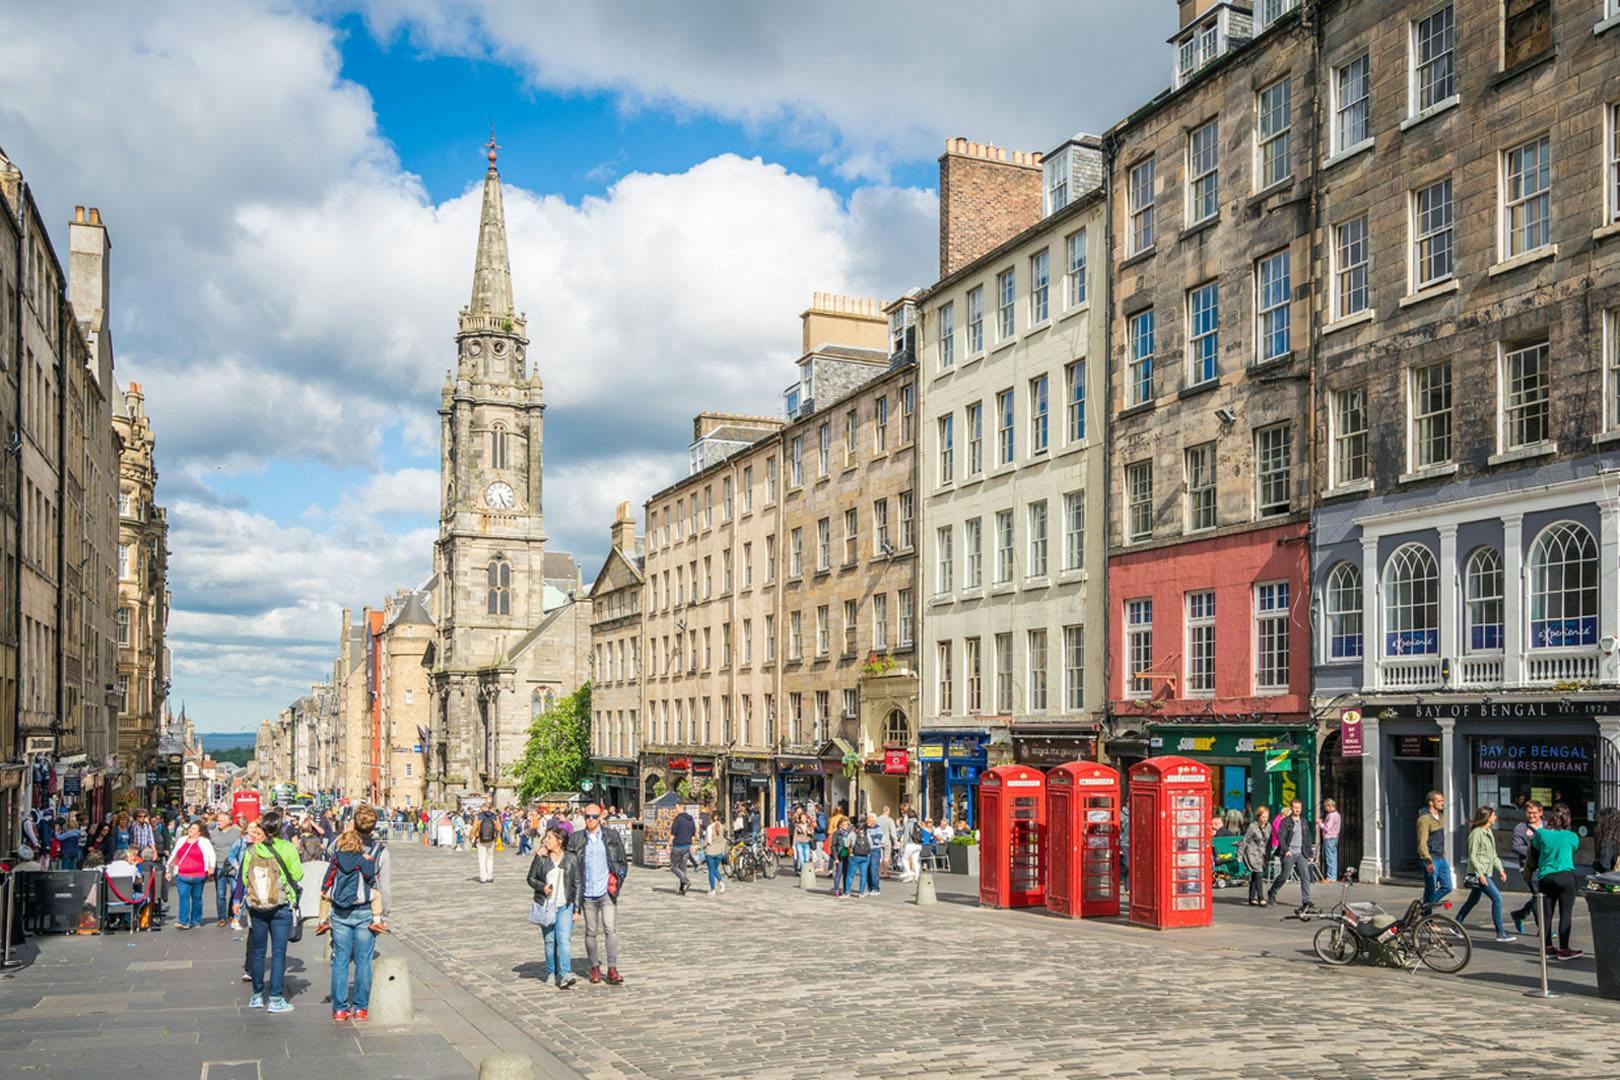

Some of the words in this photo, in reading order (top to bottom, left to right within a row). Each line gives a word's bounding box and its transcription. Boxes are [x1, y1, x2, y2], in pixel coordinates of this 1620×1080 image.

[1416, 705, 1441, 718] BAY
[1451, 704, 1470, 717] OF
[1480, 703, 1548, 717] BENGAL
[1480, 744, 1503, 757] BAY
[1508, 745, 1526, 758] OF
[1531, 745, 1588, 759] BENGAL
[1480, 759, 1516, 770] INDIAN
[1517, 760, 1589, 772] RESTAURANT
